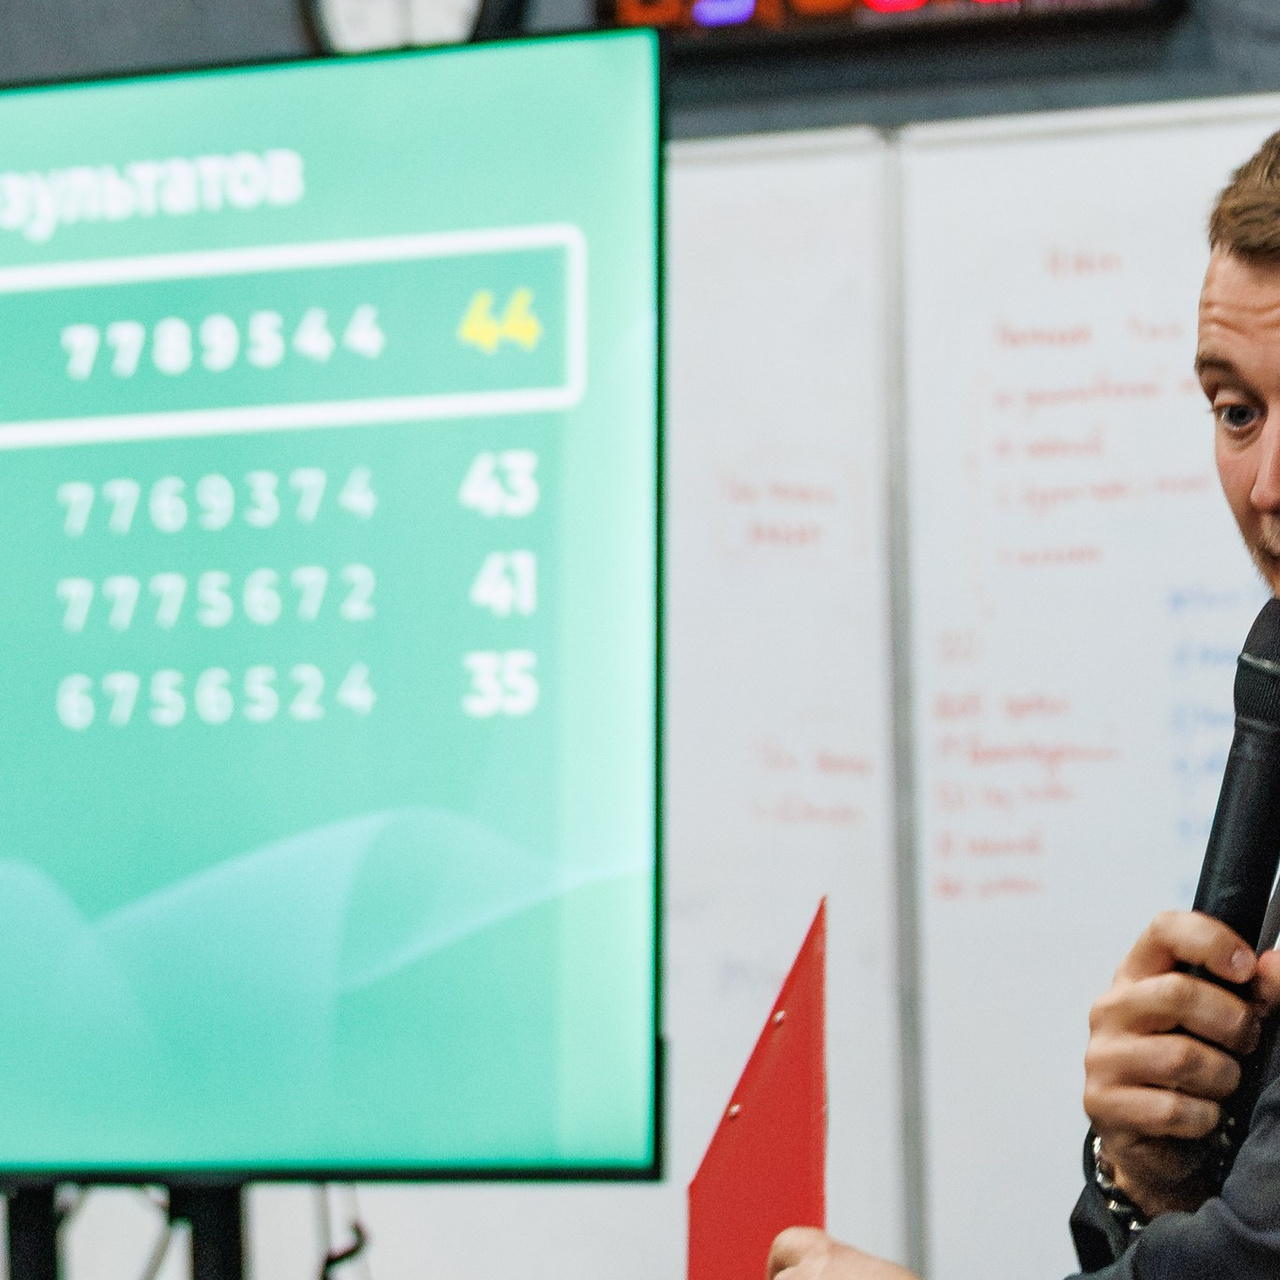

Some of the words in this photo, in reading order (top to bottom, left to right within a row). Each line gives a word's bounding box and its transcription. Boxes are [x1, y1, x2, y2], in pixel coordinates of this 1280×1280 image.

[458, 288, 541, 354] 44
[458, 450, 540, 518] 43
[469, 550, 538, 617] 41
[461, 650, 540, 719] 35
